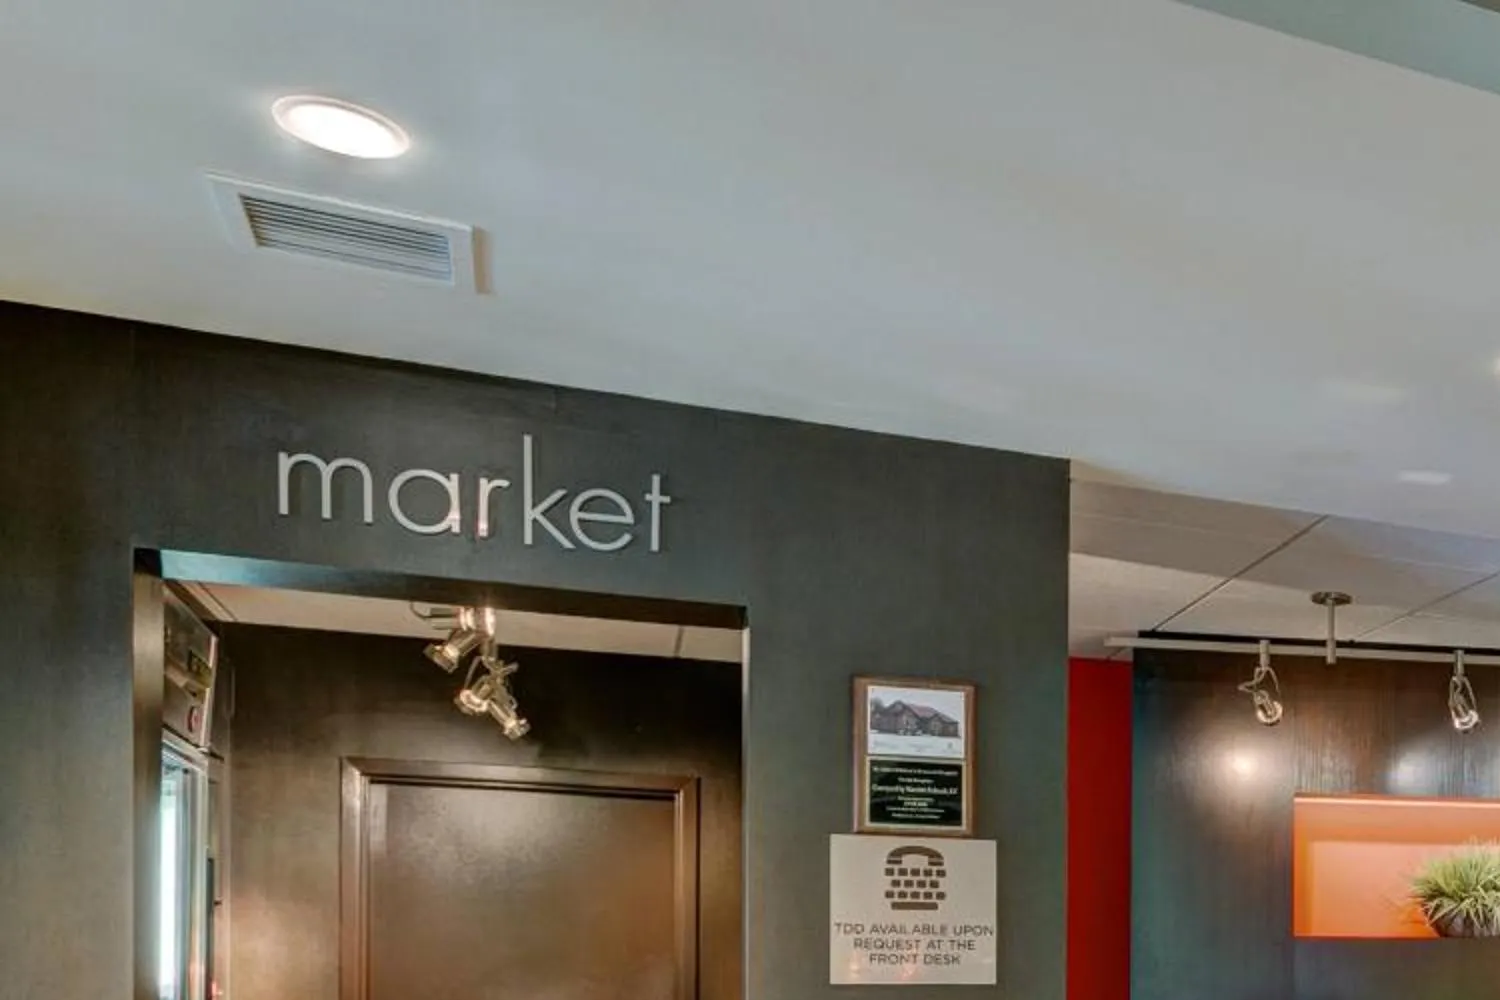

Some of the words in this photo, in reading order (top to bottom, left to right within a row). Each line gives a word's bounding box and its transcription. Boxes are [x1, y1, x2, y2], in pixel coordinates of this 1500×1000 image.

[277, 433, 671, 553] market
[834, 922, 865, 935] TDD
[869, 923, 948, 936] AVAILABLE
[953, 924, 993, 937] UPON
[853, 937, 920, 951] REQUEST
[926, 939, 944, 951] AT
[949, 939, 977, 951] THE
[869, 953, 918, 965] FRONT
[923, 953, 961, 965] DESK
